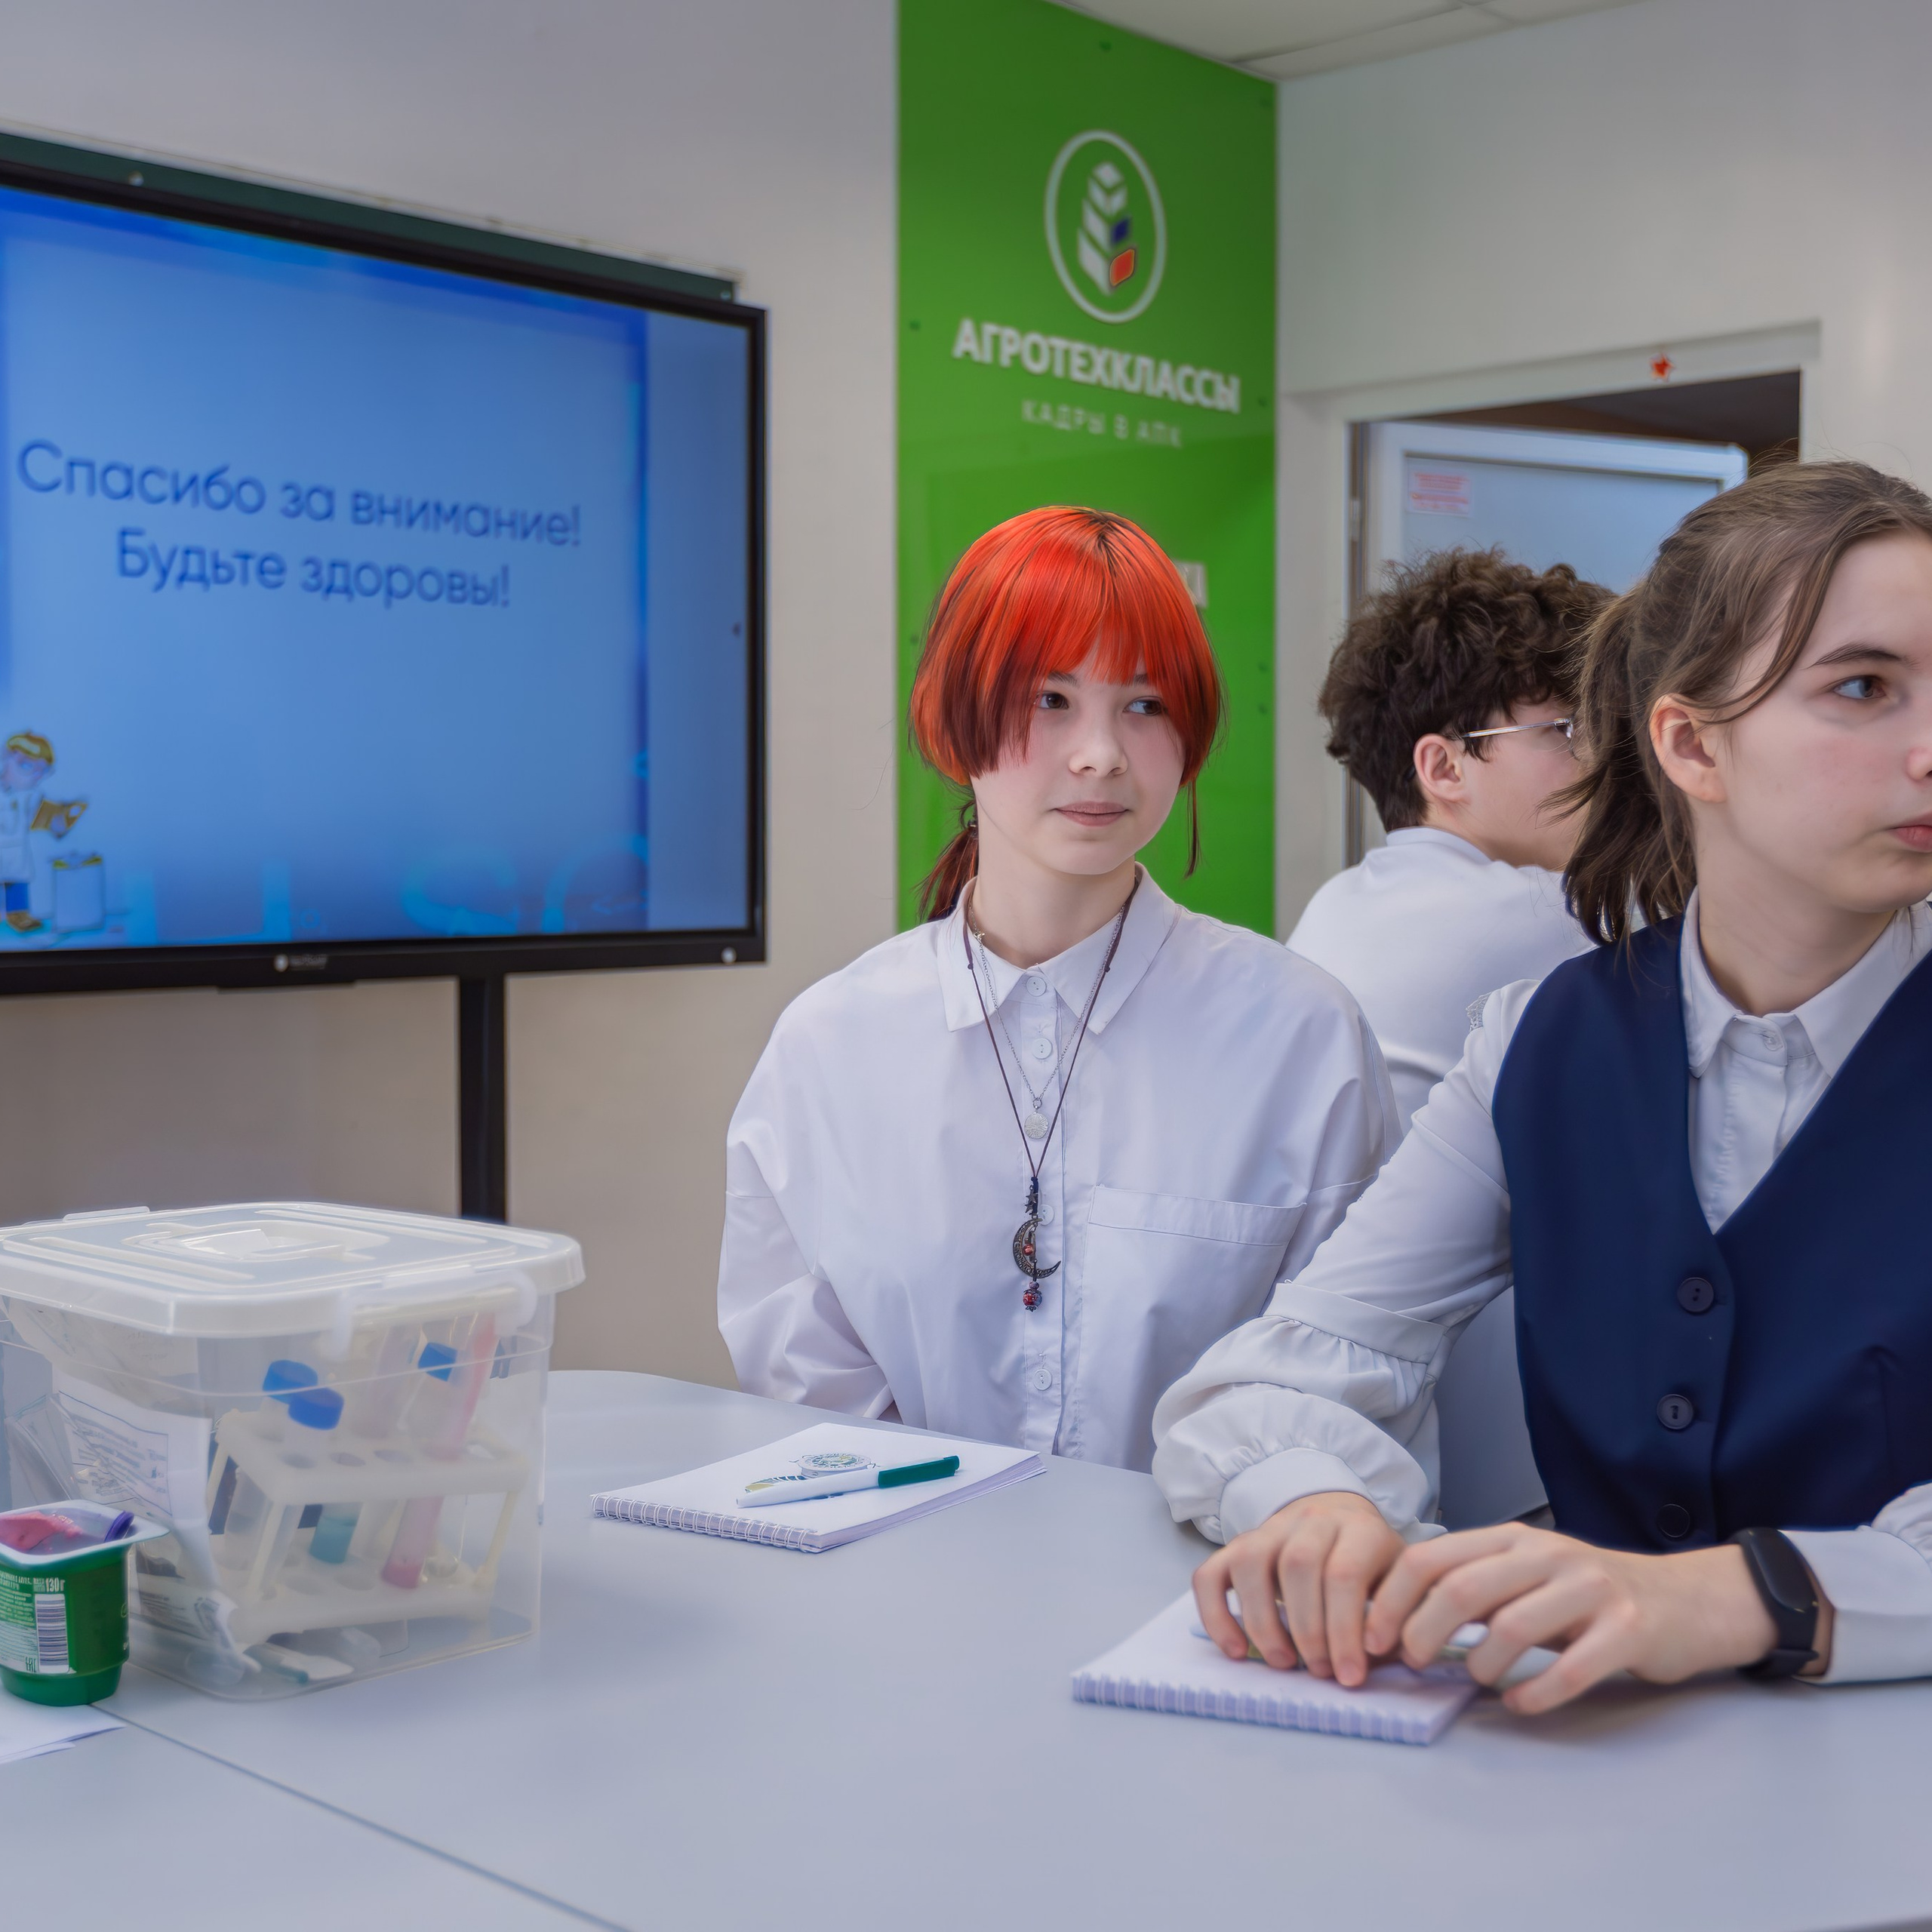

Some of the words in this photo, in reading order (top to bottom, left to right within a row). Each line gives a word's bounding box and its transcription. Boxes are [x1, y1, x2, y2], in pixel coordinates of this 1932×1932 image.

[952, 318, 1241, 414] АГРОТЕХКЛАССЫ
[1021, 400, 1105, 435] КАДРЫ
[1114, 415, 1129, 439] В
[1137, 421, 1182, 448] АПК
[17, 439, 266, 514] Спасибо
[280, 482, 334, 522] за
[350, 491, 580, 546] внимание!
[117, 527, 288, 592] Будьте
[301, 558, 509, 608] здоровы!
[45, 1577, 60, 1592] 130
